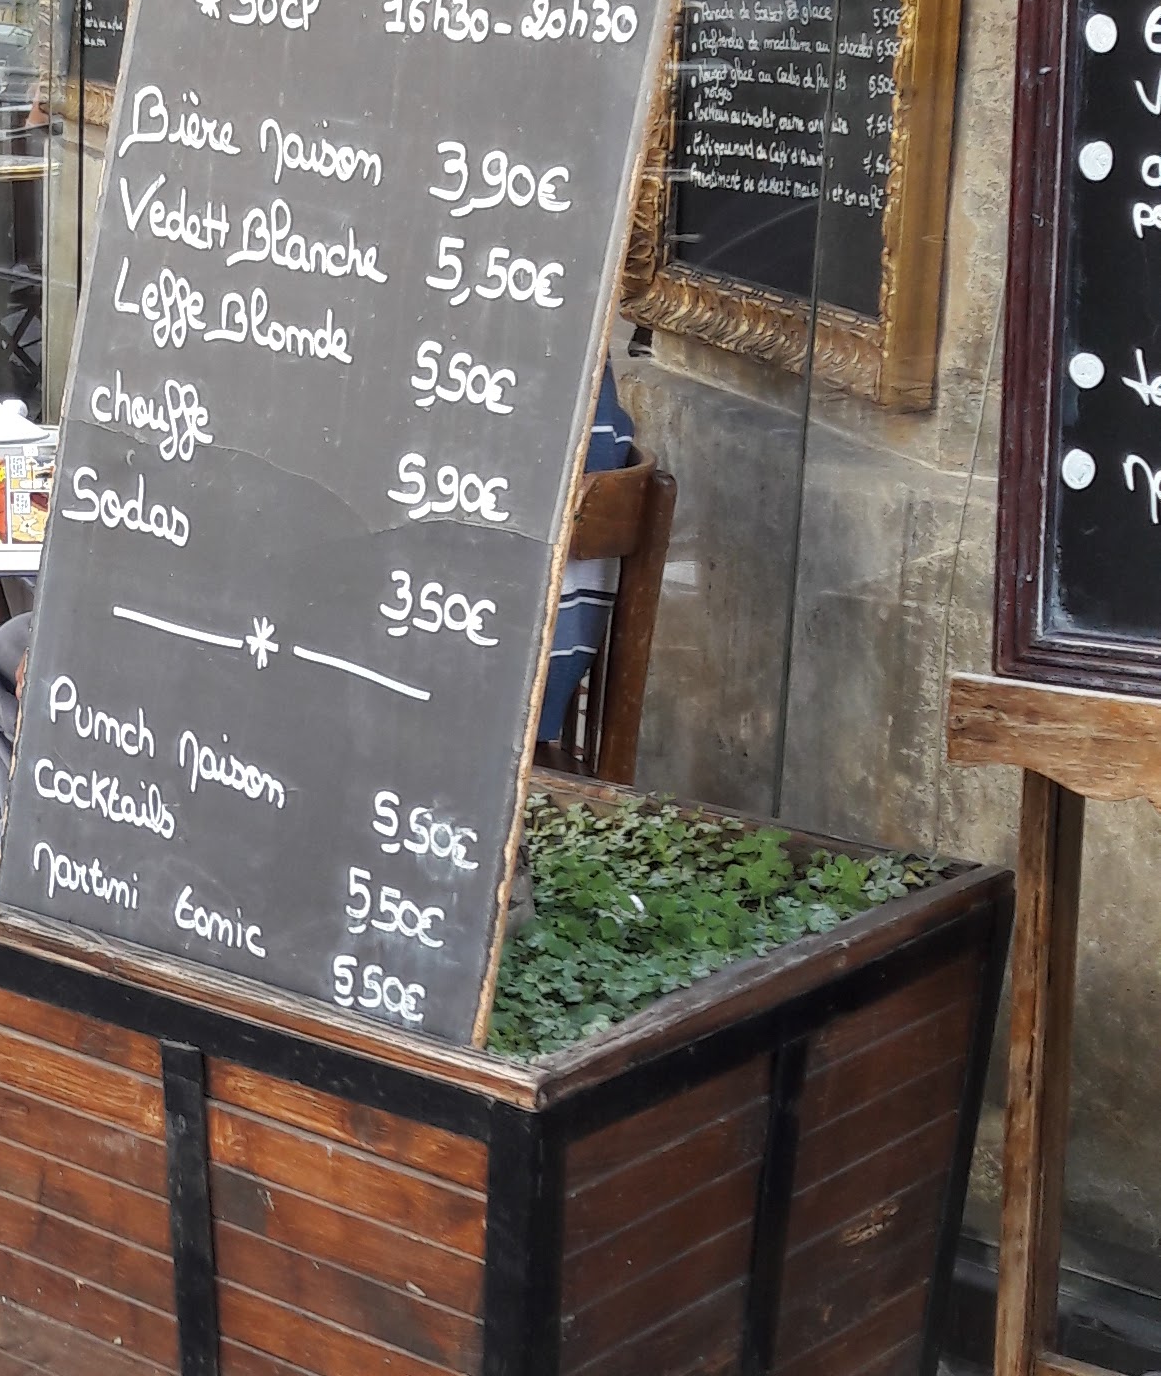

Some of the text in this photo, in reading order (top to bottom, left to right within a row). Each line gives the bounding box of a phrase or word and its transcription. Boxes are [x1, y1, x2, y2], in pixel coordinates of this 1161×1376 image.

[119, 86, 240, 157] Bière
[430, 142, 571, 216] 3,90€
[120, 174, 563, 307] Vedett Blanche 5,50€
[115, 257, 206, 347] Leffe
[62, 467, 189, 546] Sodas
[388, 453, 509, 521] 5,90€
